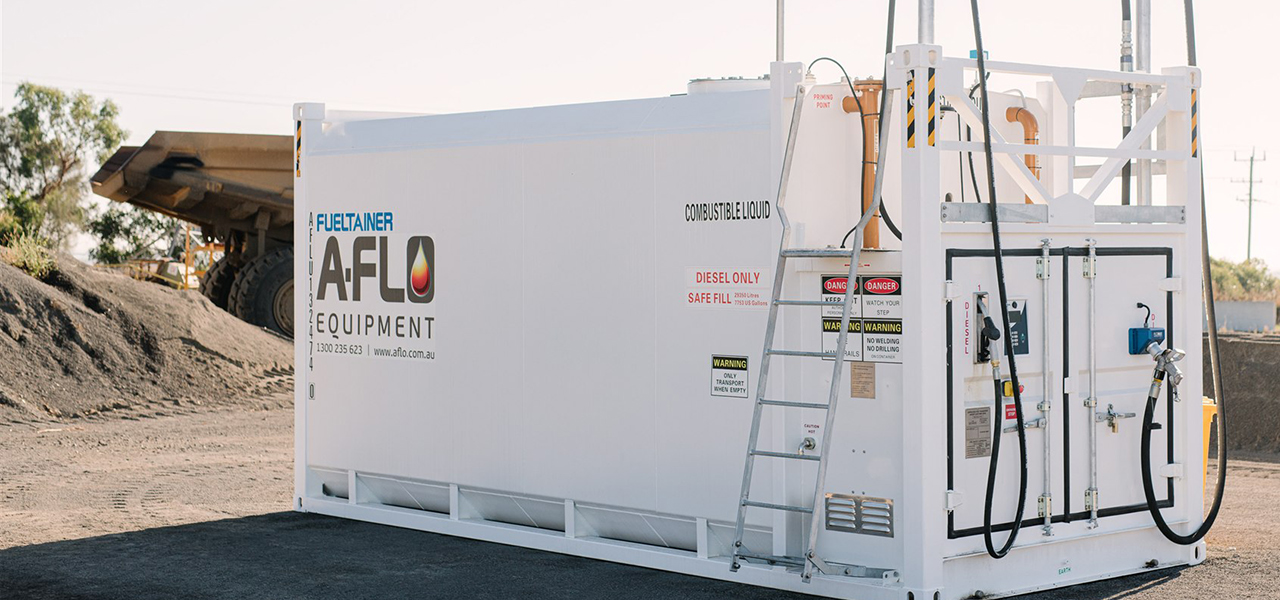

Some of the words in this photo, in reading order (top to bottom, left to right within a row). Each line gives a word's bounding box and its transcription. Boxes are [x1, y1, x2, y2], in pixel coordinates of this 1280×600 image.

[685, 202, 741, 221] COMBUSTIBLE
[742, 200, 771, 220] LIQUID
[316, 212, 393, 232] FUELTAINER
[696, 271, 730, 284] DIESEL
[732, 271, 760, 284] ONLY
[827, 281, 848, 290] DANG
[867, 282, 896, 290] DANGER
[688, 292, 711, 304] SAFE
[713, 292, 732, 304] FILL
[316, 313, 435, 339] EQUIPMENT
[824, 321, 860, 331] WARNG
[864, 323, 901, 332] WARNING
[316, 343, 333, 353] 1300
[334, 344, 348, 354] 235
[349, 345, 363, 355] 623
[374, 347, 435, 360] www.aflo.com.au
[713, 358, 747, 368] WARNING
